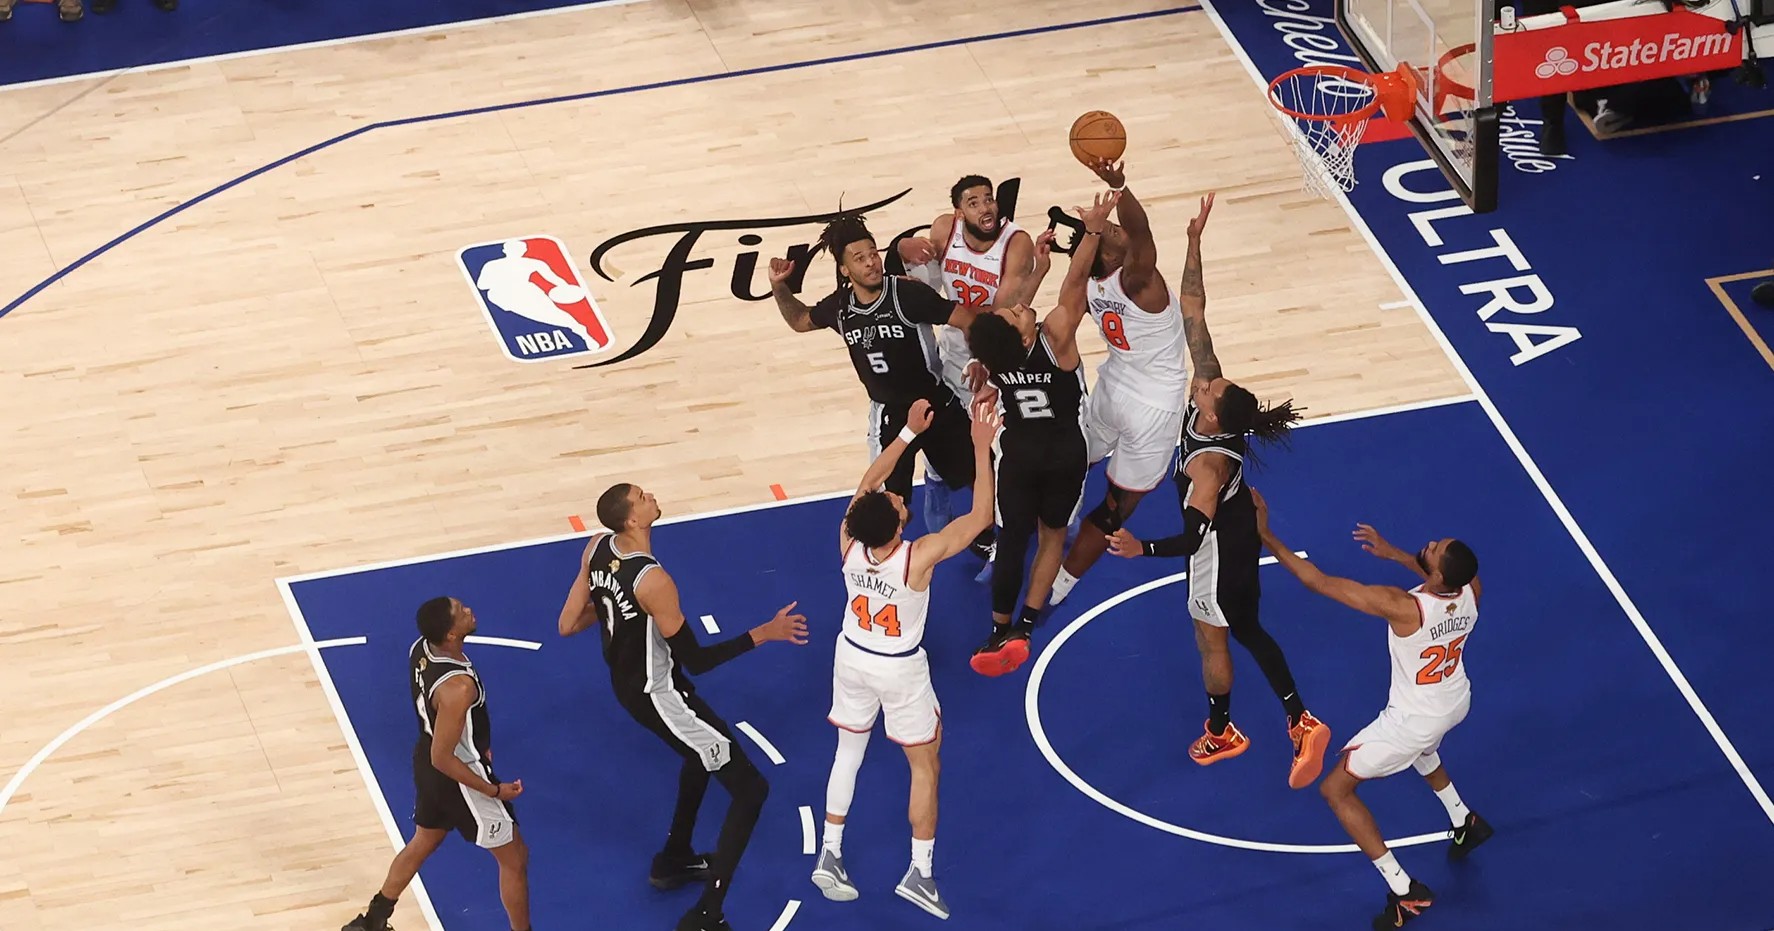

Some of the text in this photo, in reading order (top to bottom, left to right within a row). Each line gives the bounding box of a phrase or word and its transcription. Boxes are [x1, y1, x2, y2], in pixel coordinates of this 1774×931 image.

[944, 258, 999, 289] NEW YORK
[1382, 159, 1583, 367] ULTRA
[952, 279, 990, 308] 32
[515, 329, 574, 356] NBA
[1101, 310, 1131, 351] 8
[866, 351, 889, 374] 5
[997, 371, 1052, 385] HARPER
[1013, 388, 1055, 420] 2
[588, 570, 638, 621] MBANYAMA
[850, 573, 898, 599] SHAMET
[850, 594, 902, 637] 44
[1429, 616, 1471, 641] BRIDGES
[1415, 632, 1468, 686] 25
